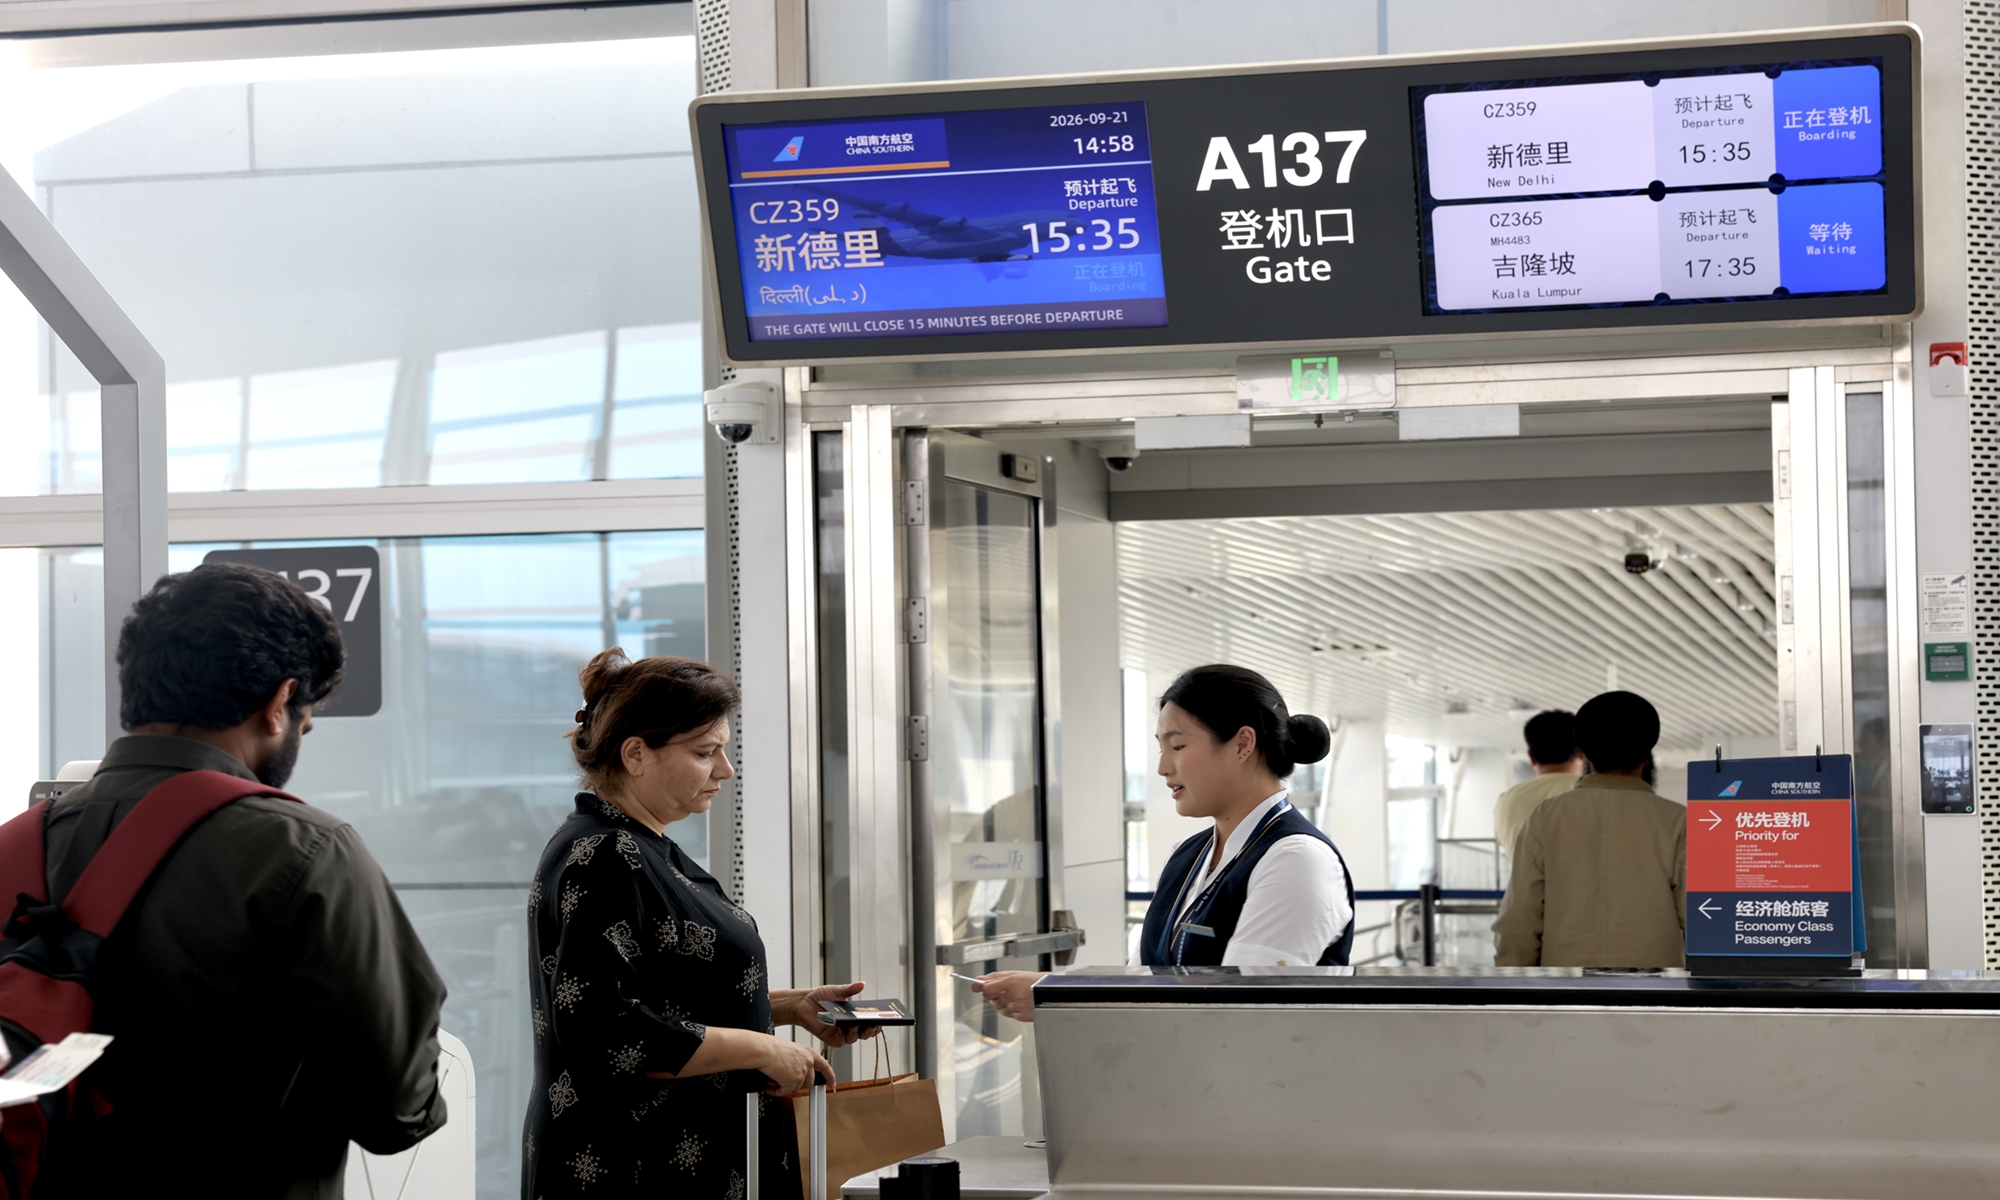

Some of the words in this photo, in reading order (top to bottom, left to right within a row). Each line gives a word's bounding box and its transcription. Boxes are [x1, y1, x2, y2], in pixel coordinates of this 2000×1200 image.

[1483, 101, 1537, 118] CZ359
[1674, 93, 1753, 114] 预计起飞
[1050, 111, 1128, 127] 2026-09-21
[1682, 117, 1745, 130] Departure
[1783, 105, 1872, 129] 正在登机
[845, 133, 913, 147] 中国南方航空
[1073, 135, 1134, 154] 14:58
[1798, 129, 1857, 142] Boarding
[846, 147, 871, 155] CHINA
[872, 145, 914, 154] SOUTHERN
[1487, 141, 1572, 169] 新德里
[1679, 141, 1751, 164] 15:35
[1196, 129, 1367, 191] A137
[1064, 178, 1137, 197] 预计起飞
[1487, 177, 1511, 188] New
[1518, 174, 1555, 187] Delhi
[750, 198, 839, 224] CZ359
[1069, 197, 1138, 211] Departure
[1489, 211, 1543, 228] CZ365
[1679, 208, 1757, 228] 预计起飞
[1022, 217, 1140, 253] 15:35
[1218, 207, 1355, 250] 登机口
[1686, 231, 1749, 244] Departure
[1809, 222, 1853, 242] 等待
[1490, 235, 1531, 246] MH4483
[754, 230, 884, 272] 新德里
[1806, 244, 1857, 256] Waiting
[1074, 261, 1146, 280] 正在登机
[1245, 255, 1332, 284] Gate
[1492, 251, 1576, 279] 吉隆坡
[1685, 256, 1756, 279] 17:35
[1089, 280, 1147, 293] Boarding
[1492, 288, 1530, 300] Kuala
[1538, 287, 1582, 300] Lumpur
[765, 325, 790, 336] THE
[794, 323, 826, 335] GATE
[829, 322, 861, 333] WILL
[864, 319, 905, 332] CLOSE
[908, 318, 924, 330] 15
[928, 315, 987, 329] MINUTES
[990, 312, 1042, 326] BEFORE
[1045, 309, 1124, 324] DEPARTURE
[277, 567, 372, 622] 37
[1771, 781, 1821, 789] 中国南方航空
[1735, 811, 1810, 828] 优先登机
[1735, 830, 1780, 843] Priority
[1782, 830, 1799, 841] for
[1735, 900, 1830, 918] 经济舱旅客
[1735, 921, 1795, 934] Economy
[1797, 921, 1834, 932] Class
[1735, 934, 1811, 947] Passengers
